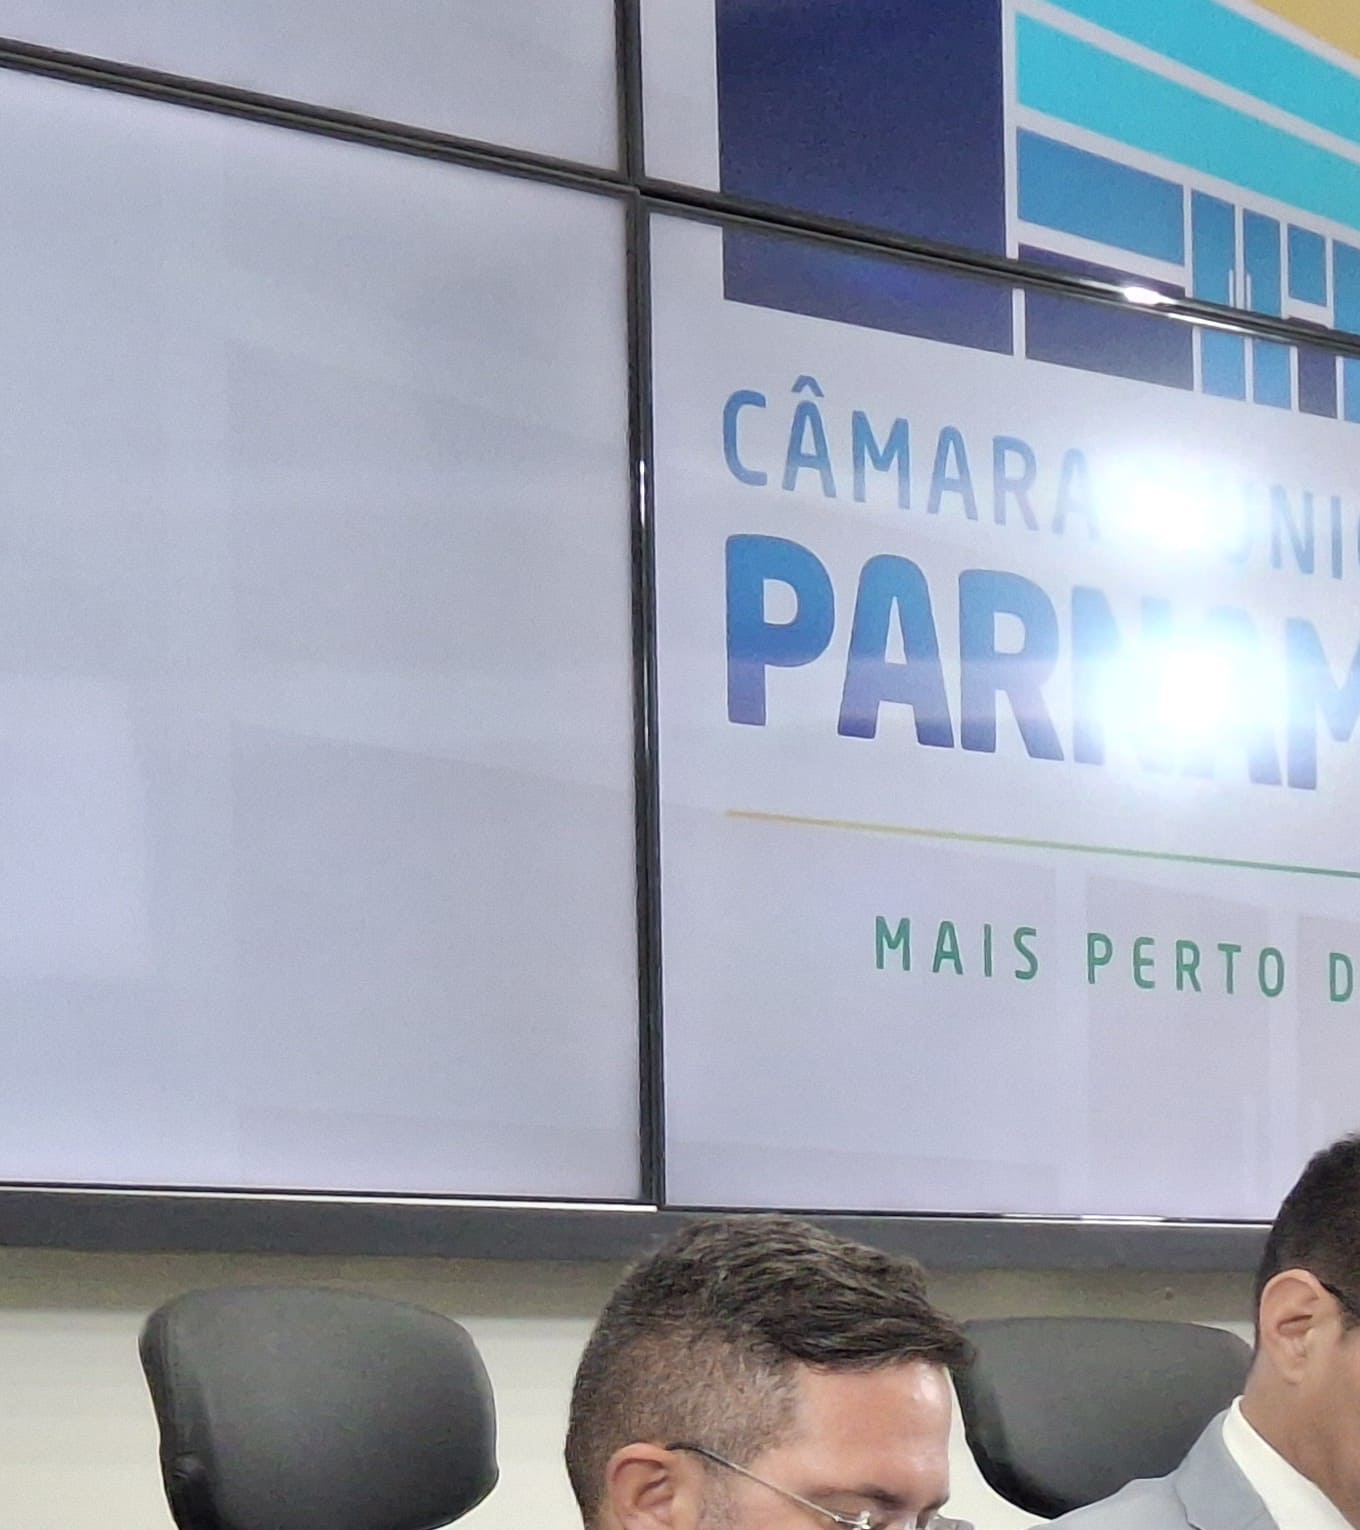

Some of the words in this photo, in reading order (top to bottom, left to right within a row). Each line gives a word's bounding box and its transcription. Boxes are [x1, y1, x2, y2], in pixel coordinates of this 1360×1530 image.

[722, 375, 1096, 539] CÂMARA
[874, 914, 1040, 982] MAIS
[1086, 930, 1286, 998] PERTO
